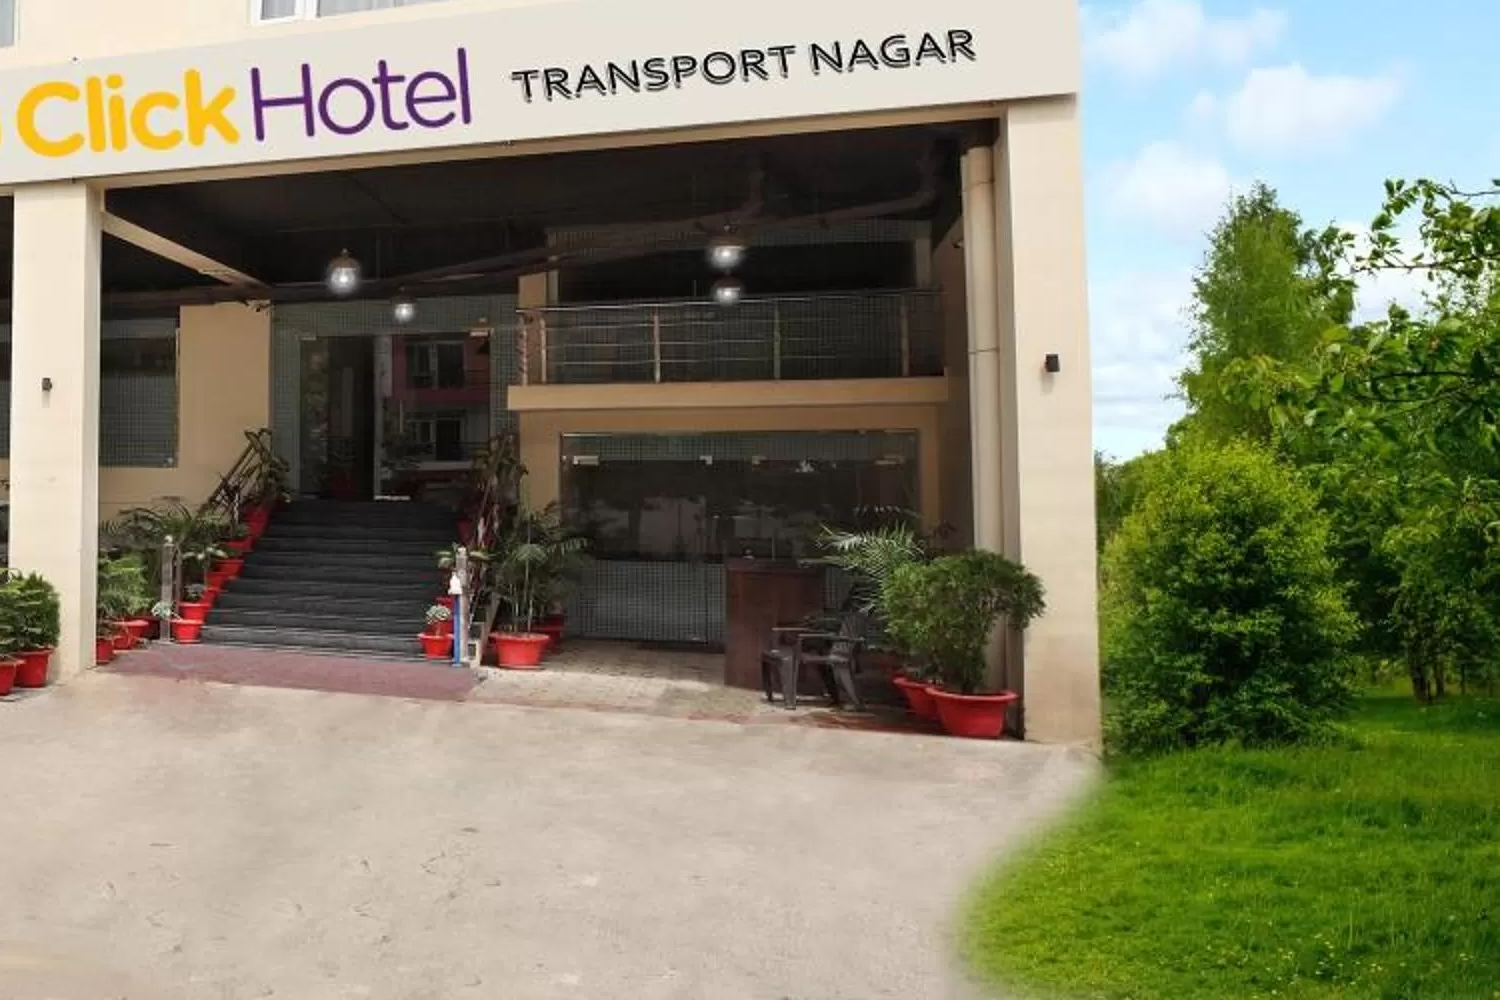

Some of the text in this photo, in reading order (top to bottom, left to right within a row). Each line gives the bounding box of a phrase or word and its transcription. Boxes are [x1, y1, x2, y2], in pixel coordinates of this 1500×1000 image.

[16, 48, 472, 158] Click Hotel
[511, 29, 977, 103] TRANSPORT NAGAR
